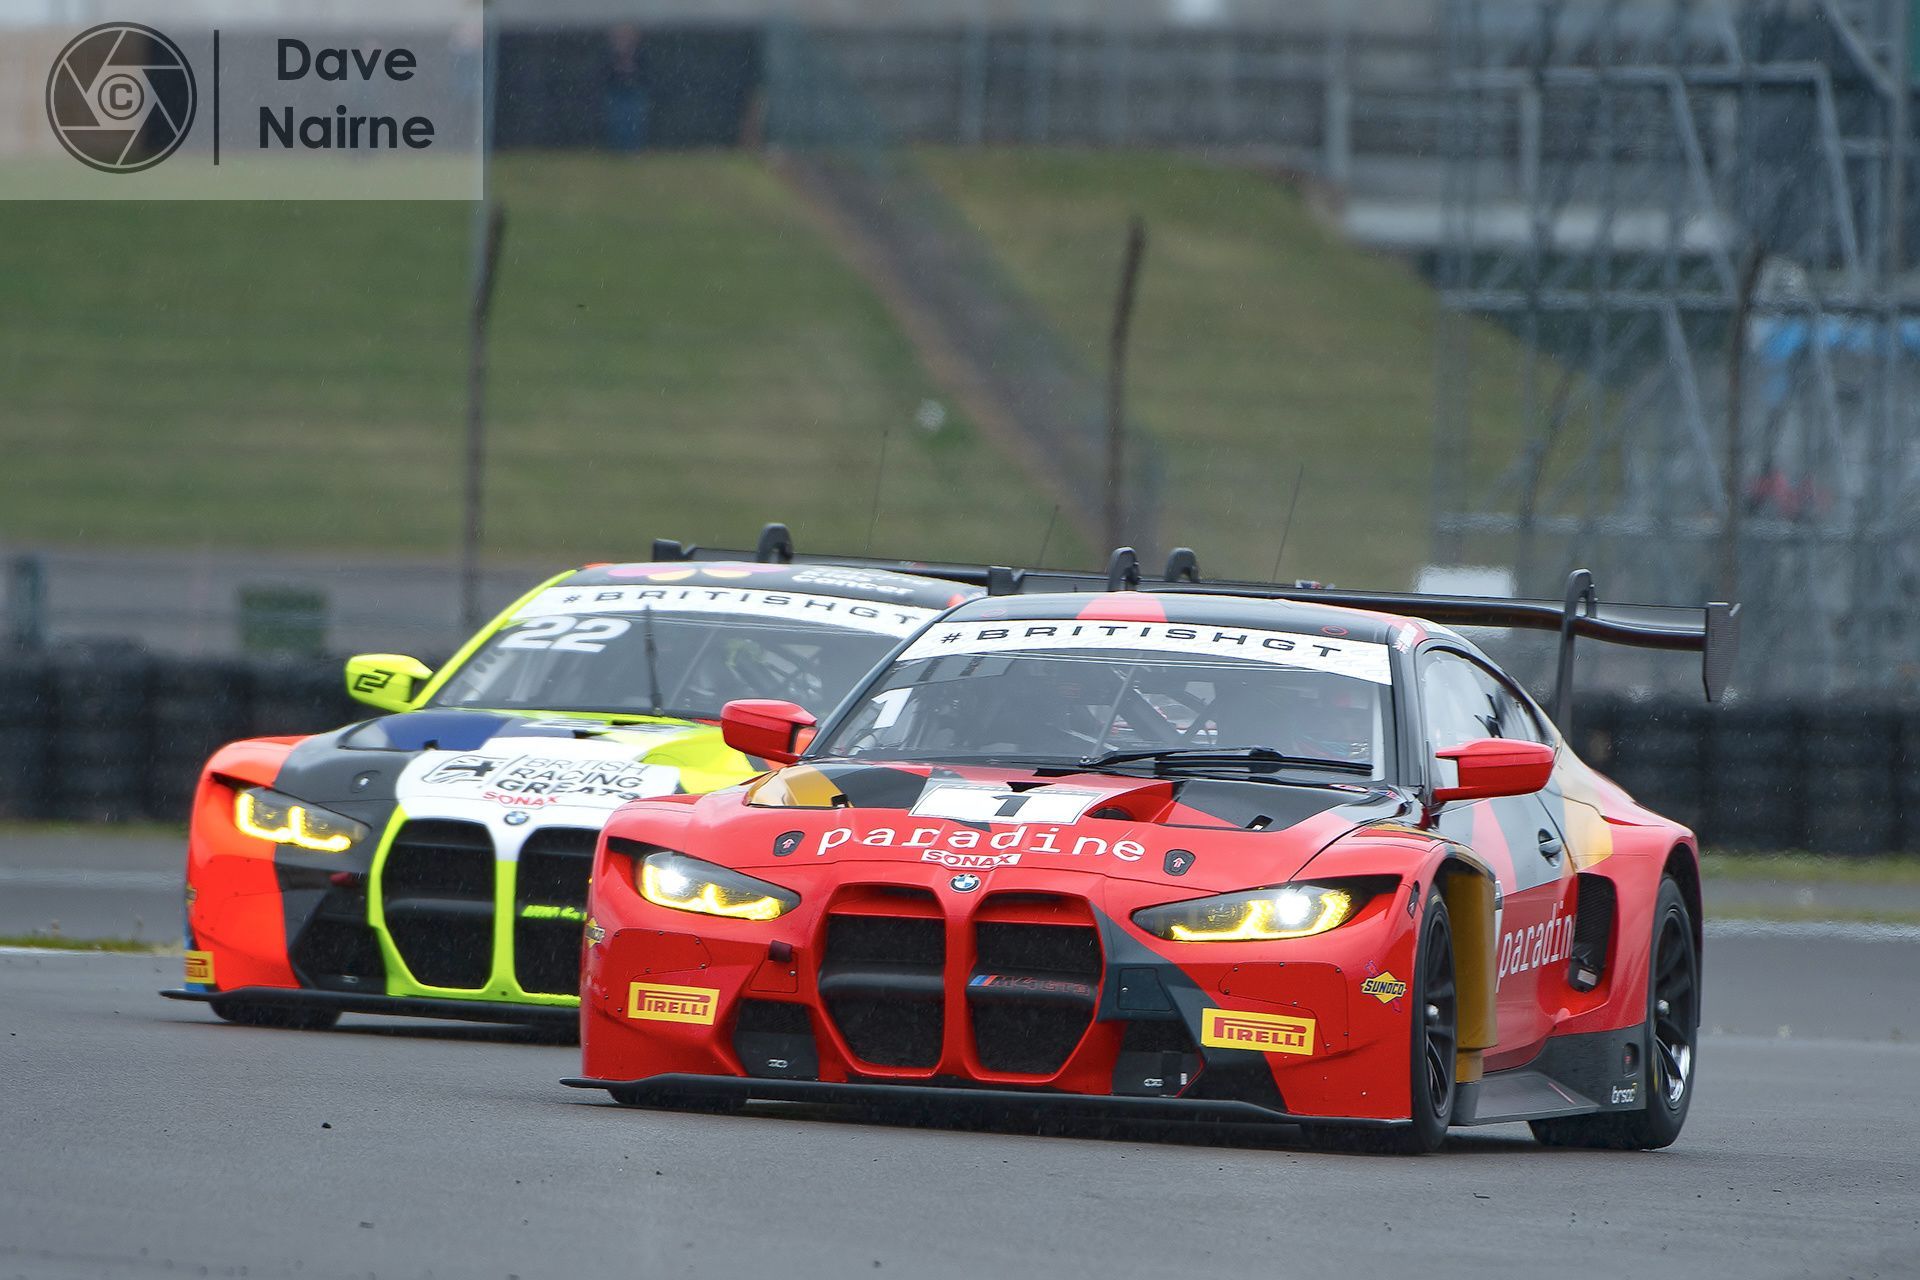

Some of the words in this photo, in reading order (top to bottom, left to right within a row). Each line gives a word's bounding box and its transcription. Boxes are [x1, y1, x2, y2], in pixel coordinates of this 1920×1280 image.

[563, 590, 920, 625] #BRITISHGT
[497, 615, 632, 653] 22
[940, 626, 1342, 659] #BRITISHGT
[871, 687, 914, 729] 1
[509, 768, 643, 788] RACING
[523, 757, 651, 775] BRITISH
[482, 791, 560, 806] SONAX
[990, 795, 1033, 817] 1
[817, 825, 1147, 862] paradine
[925, 850, 1011, 867] SONAX
[1495, 899, 1577, 994] paradin
[1363, 979, 1405, 996] SUNOCO
[636, 989, 712, 1017] PIRELLI
[1213, 1016, 1308, 1048] PIRELLI
